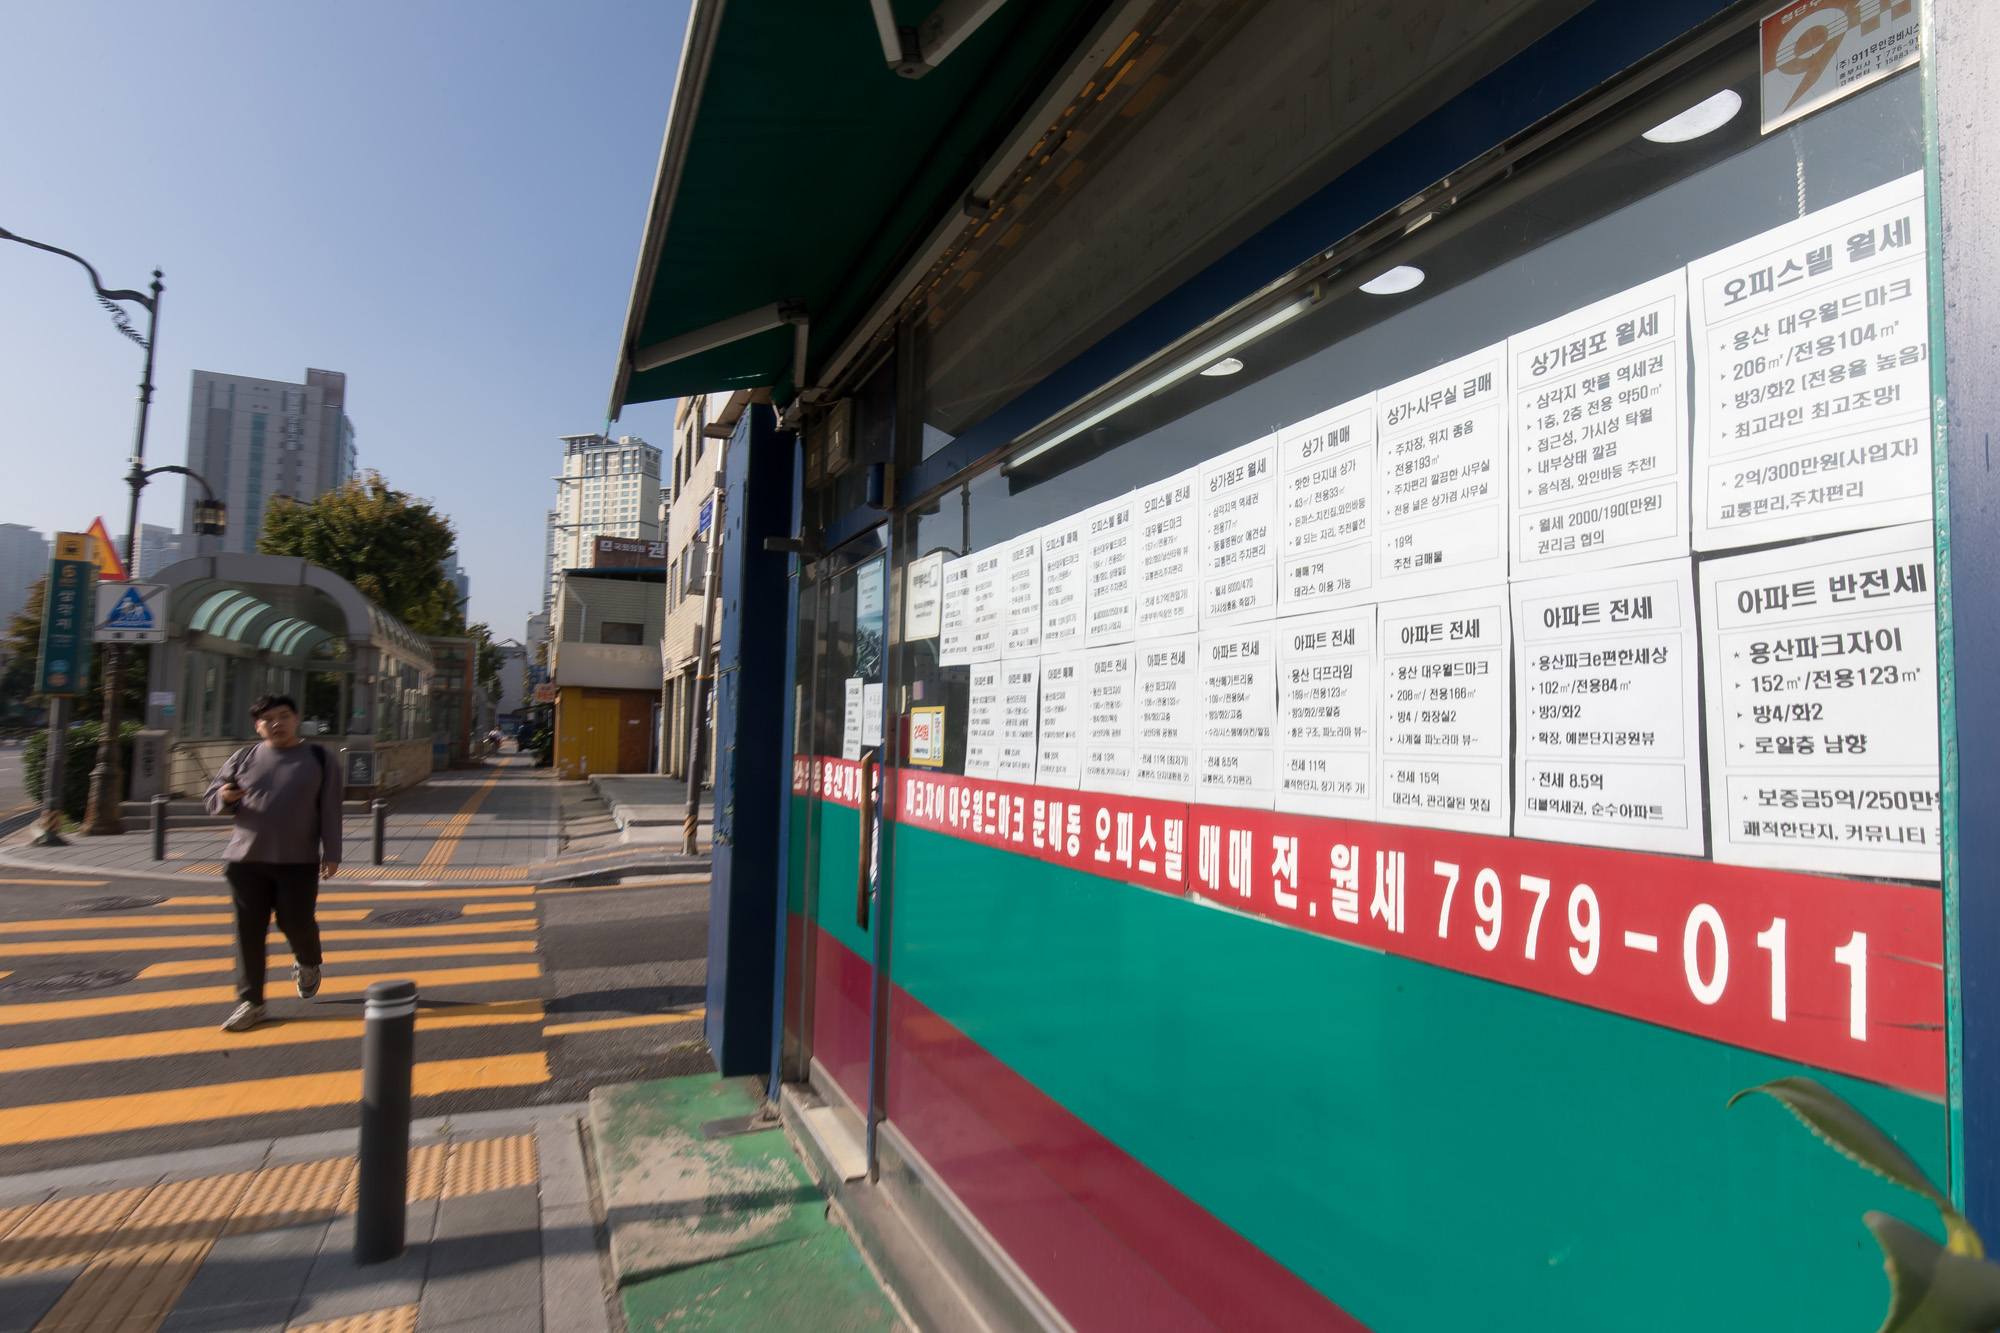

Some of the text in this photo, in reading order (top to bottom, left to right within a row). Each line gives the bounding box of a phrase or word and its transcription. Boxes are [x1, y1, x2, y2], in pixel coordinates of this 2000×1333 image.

[1840, 69, 1870, 87] 고객센터
[1724, 215, 1912, 307] 오피스텔 월세
[1732, 278, 1912, 351] 용산 대우월드마크
[1531, 311, 1659, 376] 상가점포 월세
[1463, 372, 1492, 399] 급매
[1536, 355, 1664, 409] 삼각지 핫플 역세권
[1734, 379, 1795, 409] 방3/화2
[1537, 415, 1559, 430] 1층,
[1563, 406, 1582, 423] 2층
[1588, 396, 1613, 416] 전용
[1735, 407, 1803, 439] 최고라인
[1302, 425, 1350, 458] 상가 매매
[1396, 420, 1473, 456] 주차장, 위치 좋음
[1538, 407, 1653, 453] 접근성, 가시성 탁월
[1538, 441, 1617, 474] 내부상태 깔끔
[1210, 458, 1266, 492] 상가점포 월세
[1313, 466, 1337, 485] 단지내
[1340, 459, 1356, 476] 상가
[1394, 458, 1490, 495] 주차편리 깔끔한 사무실
[1538, 478, 1574, 496] 음식점,
[1578, 464, 1623, 487] 와인바등
[1144, 492, 1172, 514] 오피스텔
[1394, 482, 1488, 516] 전용 넓은 상가겸 사무실
[1539, 515, 1564, 533] 월세
[1304, 533, 1317, 544] 되는
[1538, 530, 1605, 554] 권리금 협의
[1394, 550, 1443, 571] 추천 급매물
[1294, 578, 1351, 597] 테라스 이용 가능
[1737, 563, 1927, 614] 아파트 반전세
[1543, 595, 1653, 628] 아파트 전세
[1294, 628, 1355, 651] 아파트 전세
[1401, 618, 1480, 644] 아파트 전세
[1212, 640, 1259, 660] 아파트 전세
[1749, 627, 1902, 664] 용산파크자이
[1398, 661, 1489, 681] 용산 대우월드마크
[1539, 646, 1668, 671] 용산파크e편한세상
[1292, 664, 1352, 683] 용산 더프라임
[1398, 710, 1411, 723] 방4
[1422, 710, 1456, 722] 화장실2
[1539, 704, 1582, 719] 방3/화2
[1753, 703, 1824, 724] 방4/화2
[1397, 734, 1421, 745] 사계절
[1425, 734, 1459, 746] 파노라마
[1539, 732, 1655, 746] 확장, 예쁜단지공원뷰
[1755, 734, 1867, 755] 로얄층 남향
[1291, 759, 1305, 771] 전세
[1397, 770, 1439, 785] 전세 15억
[1338, 781, 1352, 793] 거주
[1539, 772, 1604, 790] 전세 8.5억
[1392, 792, 1490, 812] 대리석, 관리잘된 멋집
[1527, 798, 1664, 820] 더블역세권, 순수아파트
[1743, 820, 1839, 841] 쾌적한단지,
[1846, 824, 1926, 845] 커뮤니티
[906, 779, 945, 824] 파크자이
[949, 785, 1024, 842] 대우월드마크
[1033, 799, 1081, 857] 문배동
[1094, 807, 1184, 882] 오피스텔
[1198, 824, 1253, 898] 매매
[1433, 860, 1868, 1042] 7979-011
